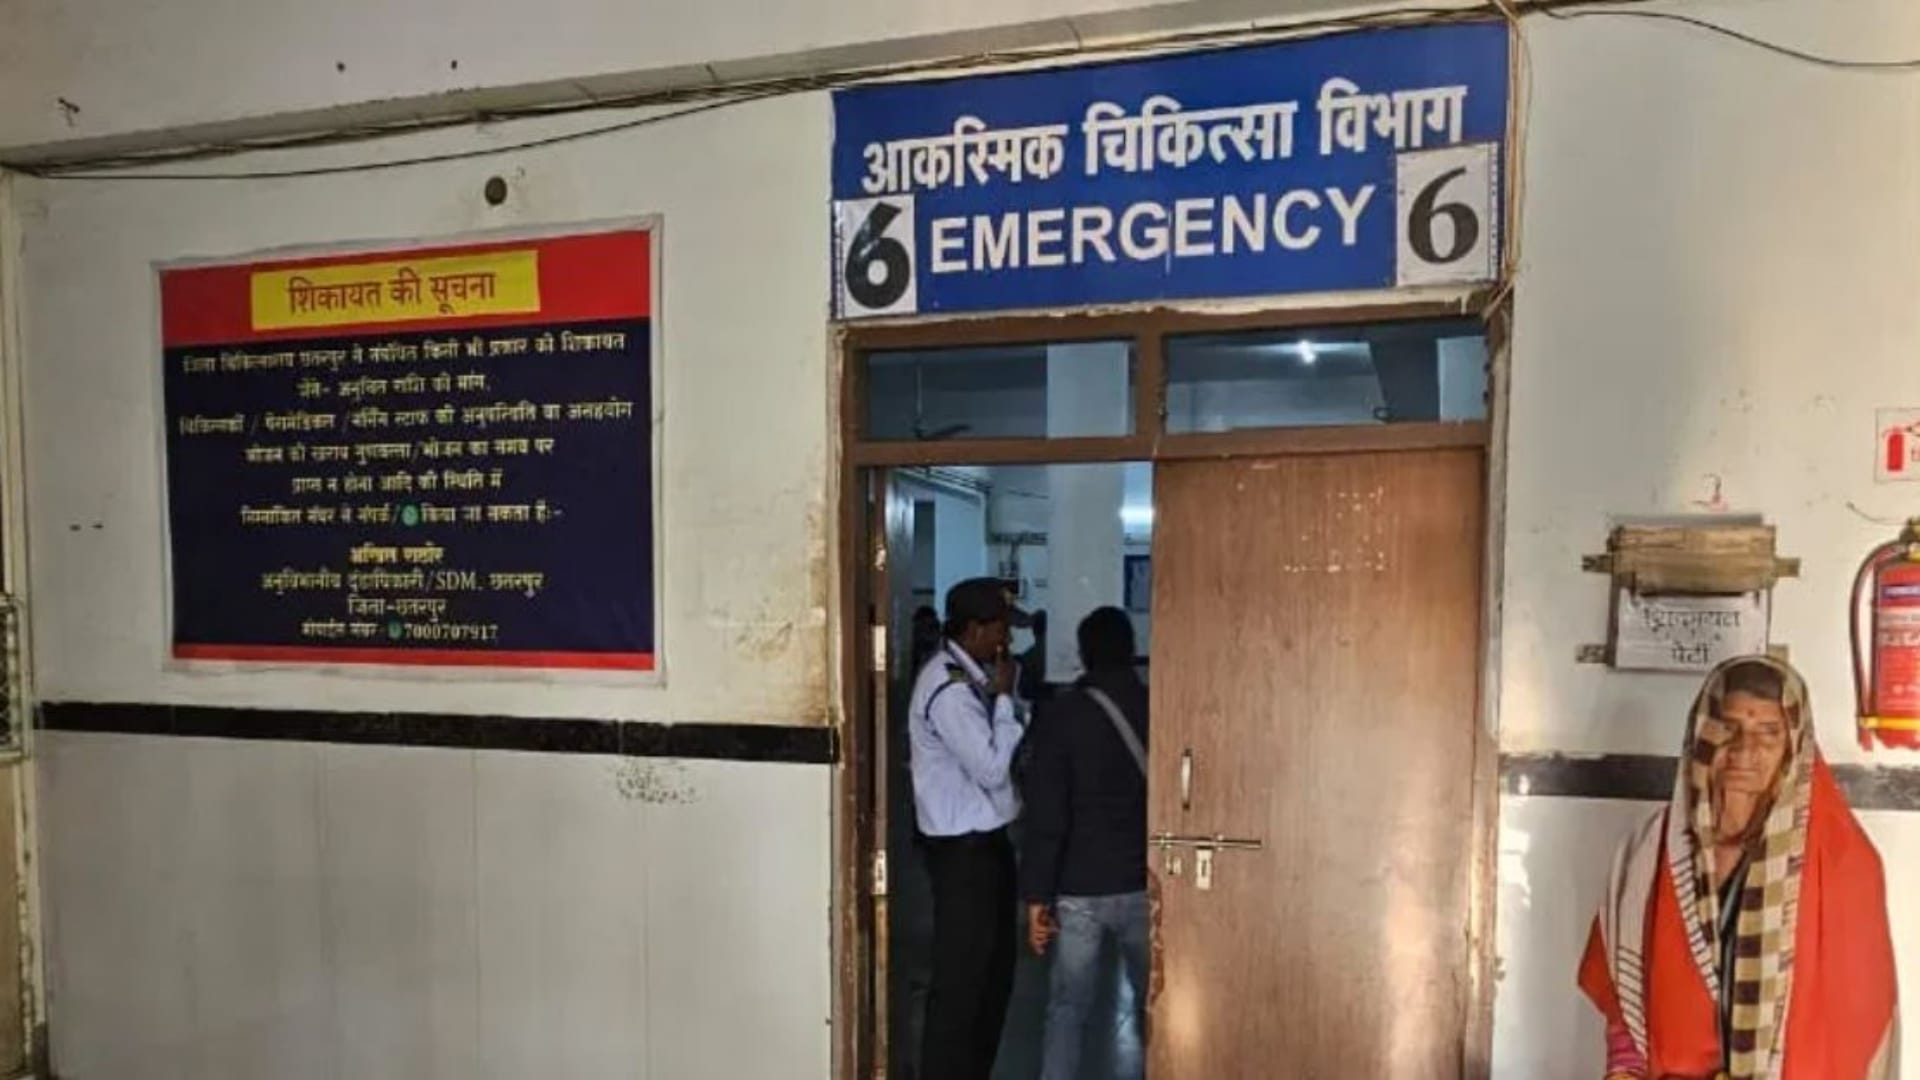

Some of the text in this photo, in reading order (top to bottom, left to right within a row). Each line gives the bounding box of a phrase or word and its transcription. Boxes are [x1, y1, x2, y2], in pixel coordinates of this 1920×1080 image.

[862, 78, 1468, 193] आकस्मिक चिकित्सा विभाग
[844, 202, 911, 309] 6
[930, 185, 1376, 274] EMERGENCY
[1408, 166, 1480, 265] 6
[288, 267, 495, 315] शिकायत की सूचना
[466, 336, 483, 358] भी
[489, 337, 527, 357] प्रकार
[561, 330, 625, 353] शिकायत
[534, 438, 555, 453] पर
